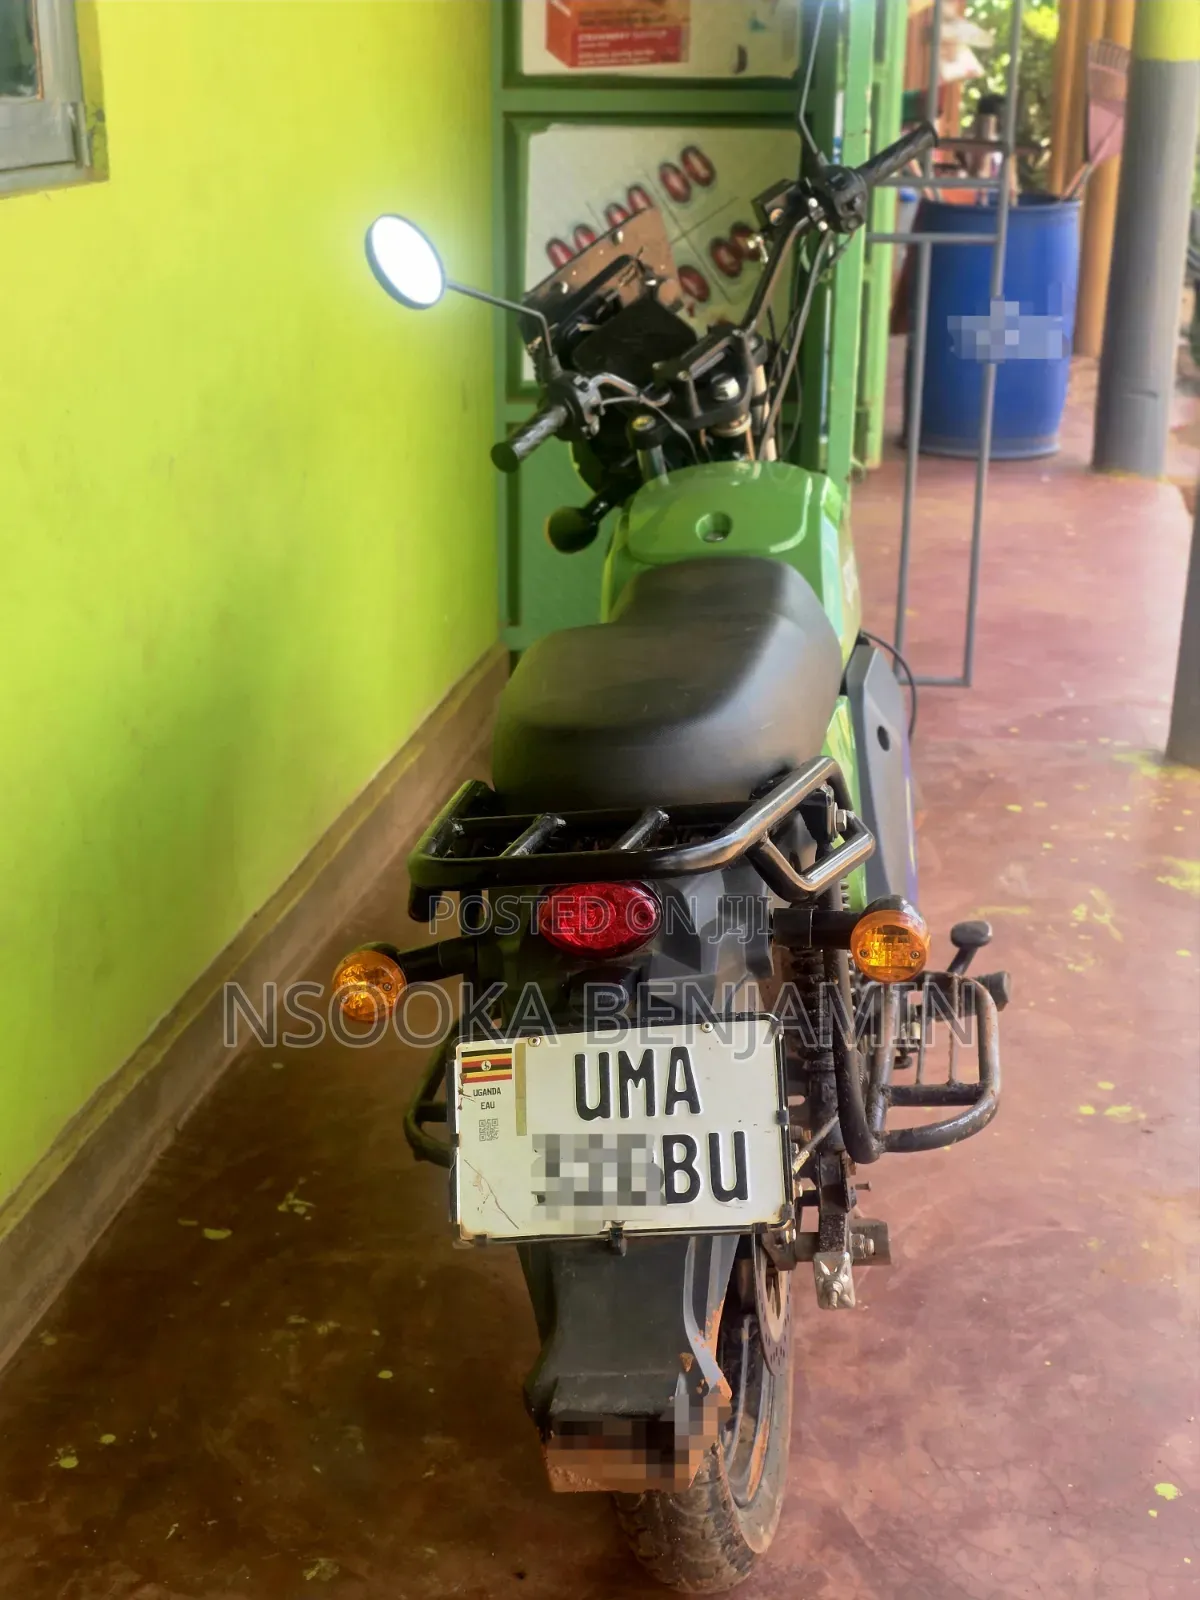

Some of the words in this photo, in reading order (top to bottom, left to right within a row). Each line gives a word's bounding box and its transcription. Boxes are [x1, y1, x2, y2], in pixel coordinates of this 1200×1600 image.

[574, 1047, 700, 1120] UMA
[473, 1087, 501, 1097] UGANDA
[480, 1101, 495, 1110] EAU
